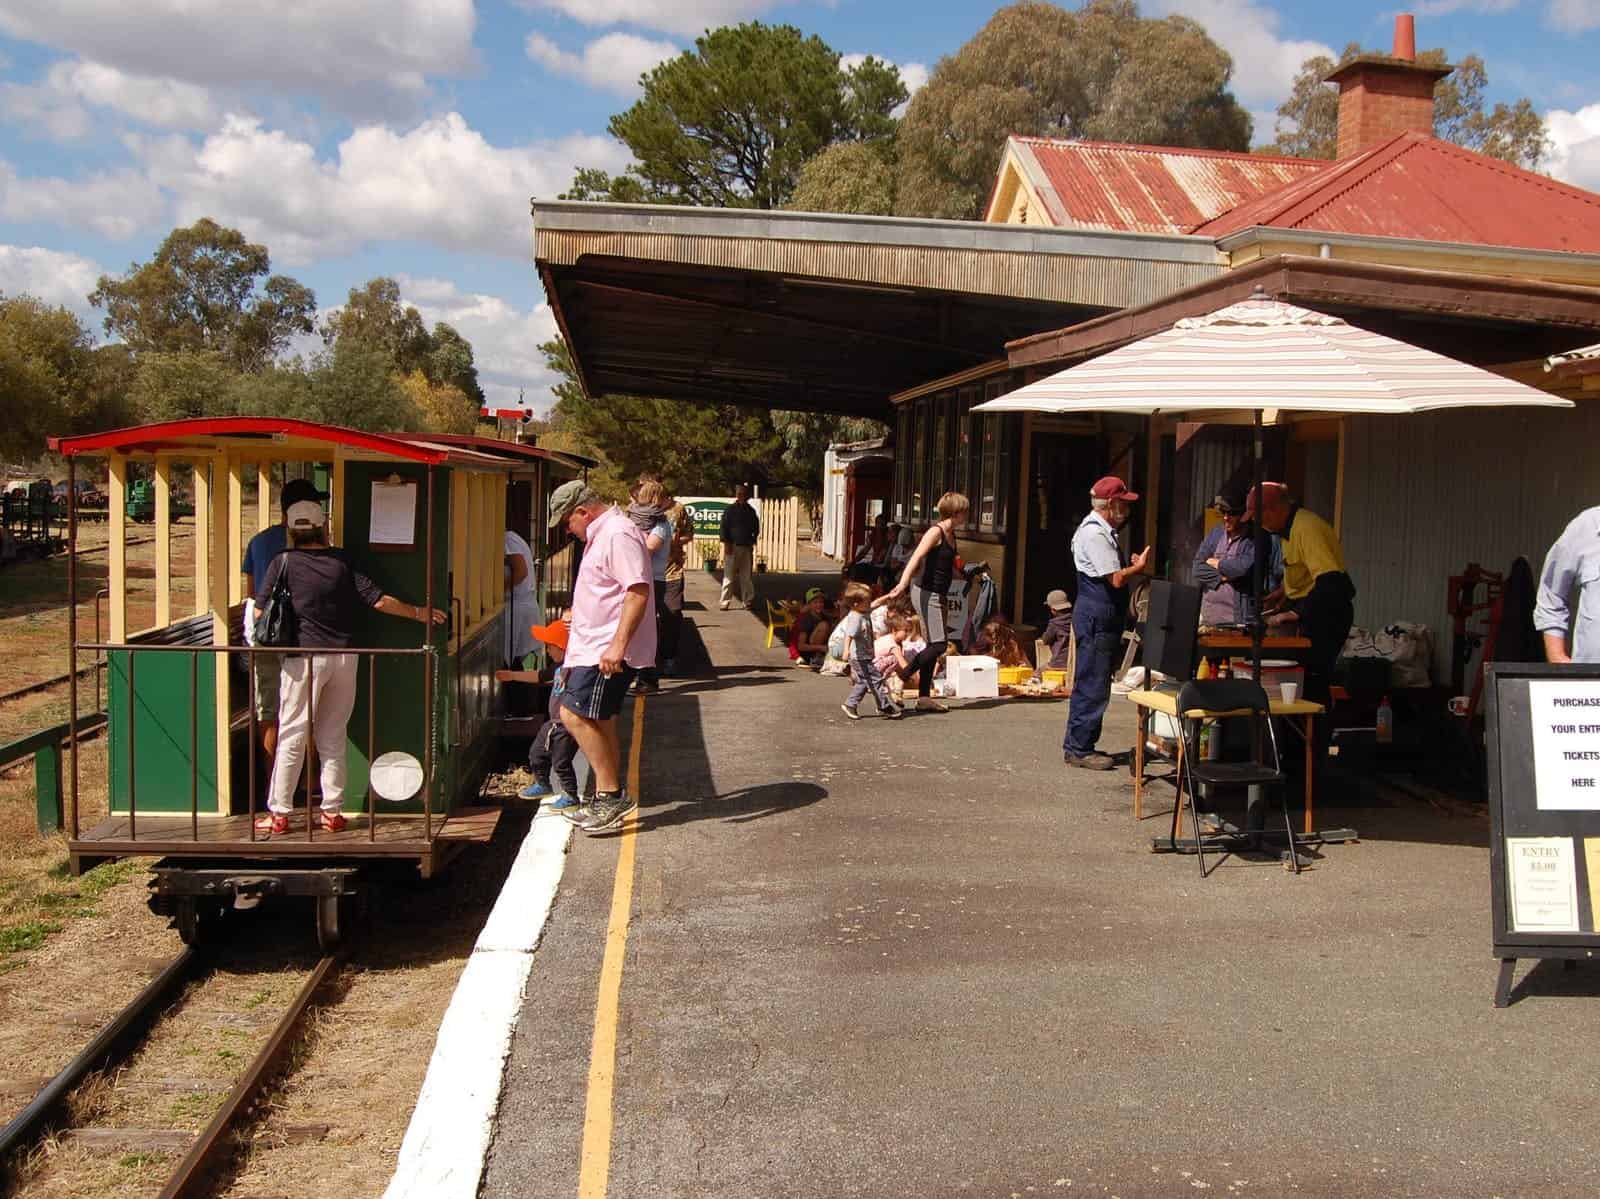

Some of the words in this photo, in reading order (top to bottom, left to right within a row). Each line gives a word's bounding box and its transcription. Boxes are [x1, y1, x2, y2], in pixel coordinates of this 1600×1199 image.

[685, 505, 725, 521] Peter
[949, 600, 962, 611] EN
[1553, 698, 1600, 707] PURCHASE
[1551, 725, 1576, 734] YOUR
[1579, 725, 1600, 734] ENTR
[1562, 751, 1600, 760] TICKETS
[1571, 778, 1595, 787] HERE
[1521, 847, 1560, 857] ENTRY
